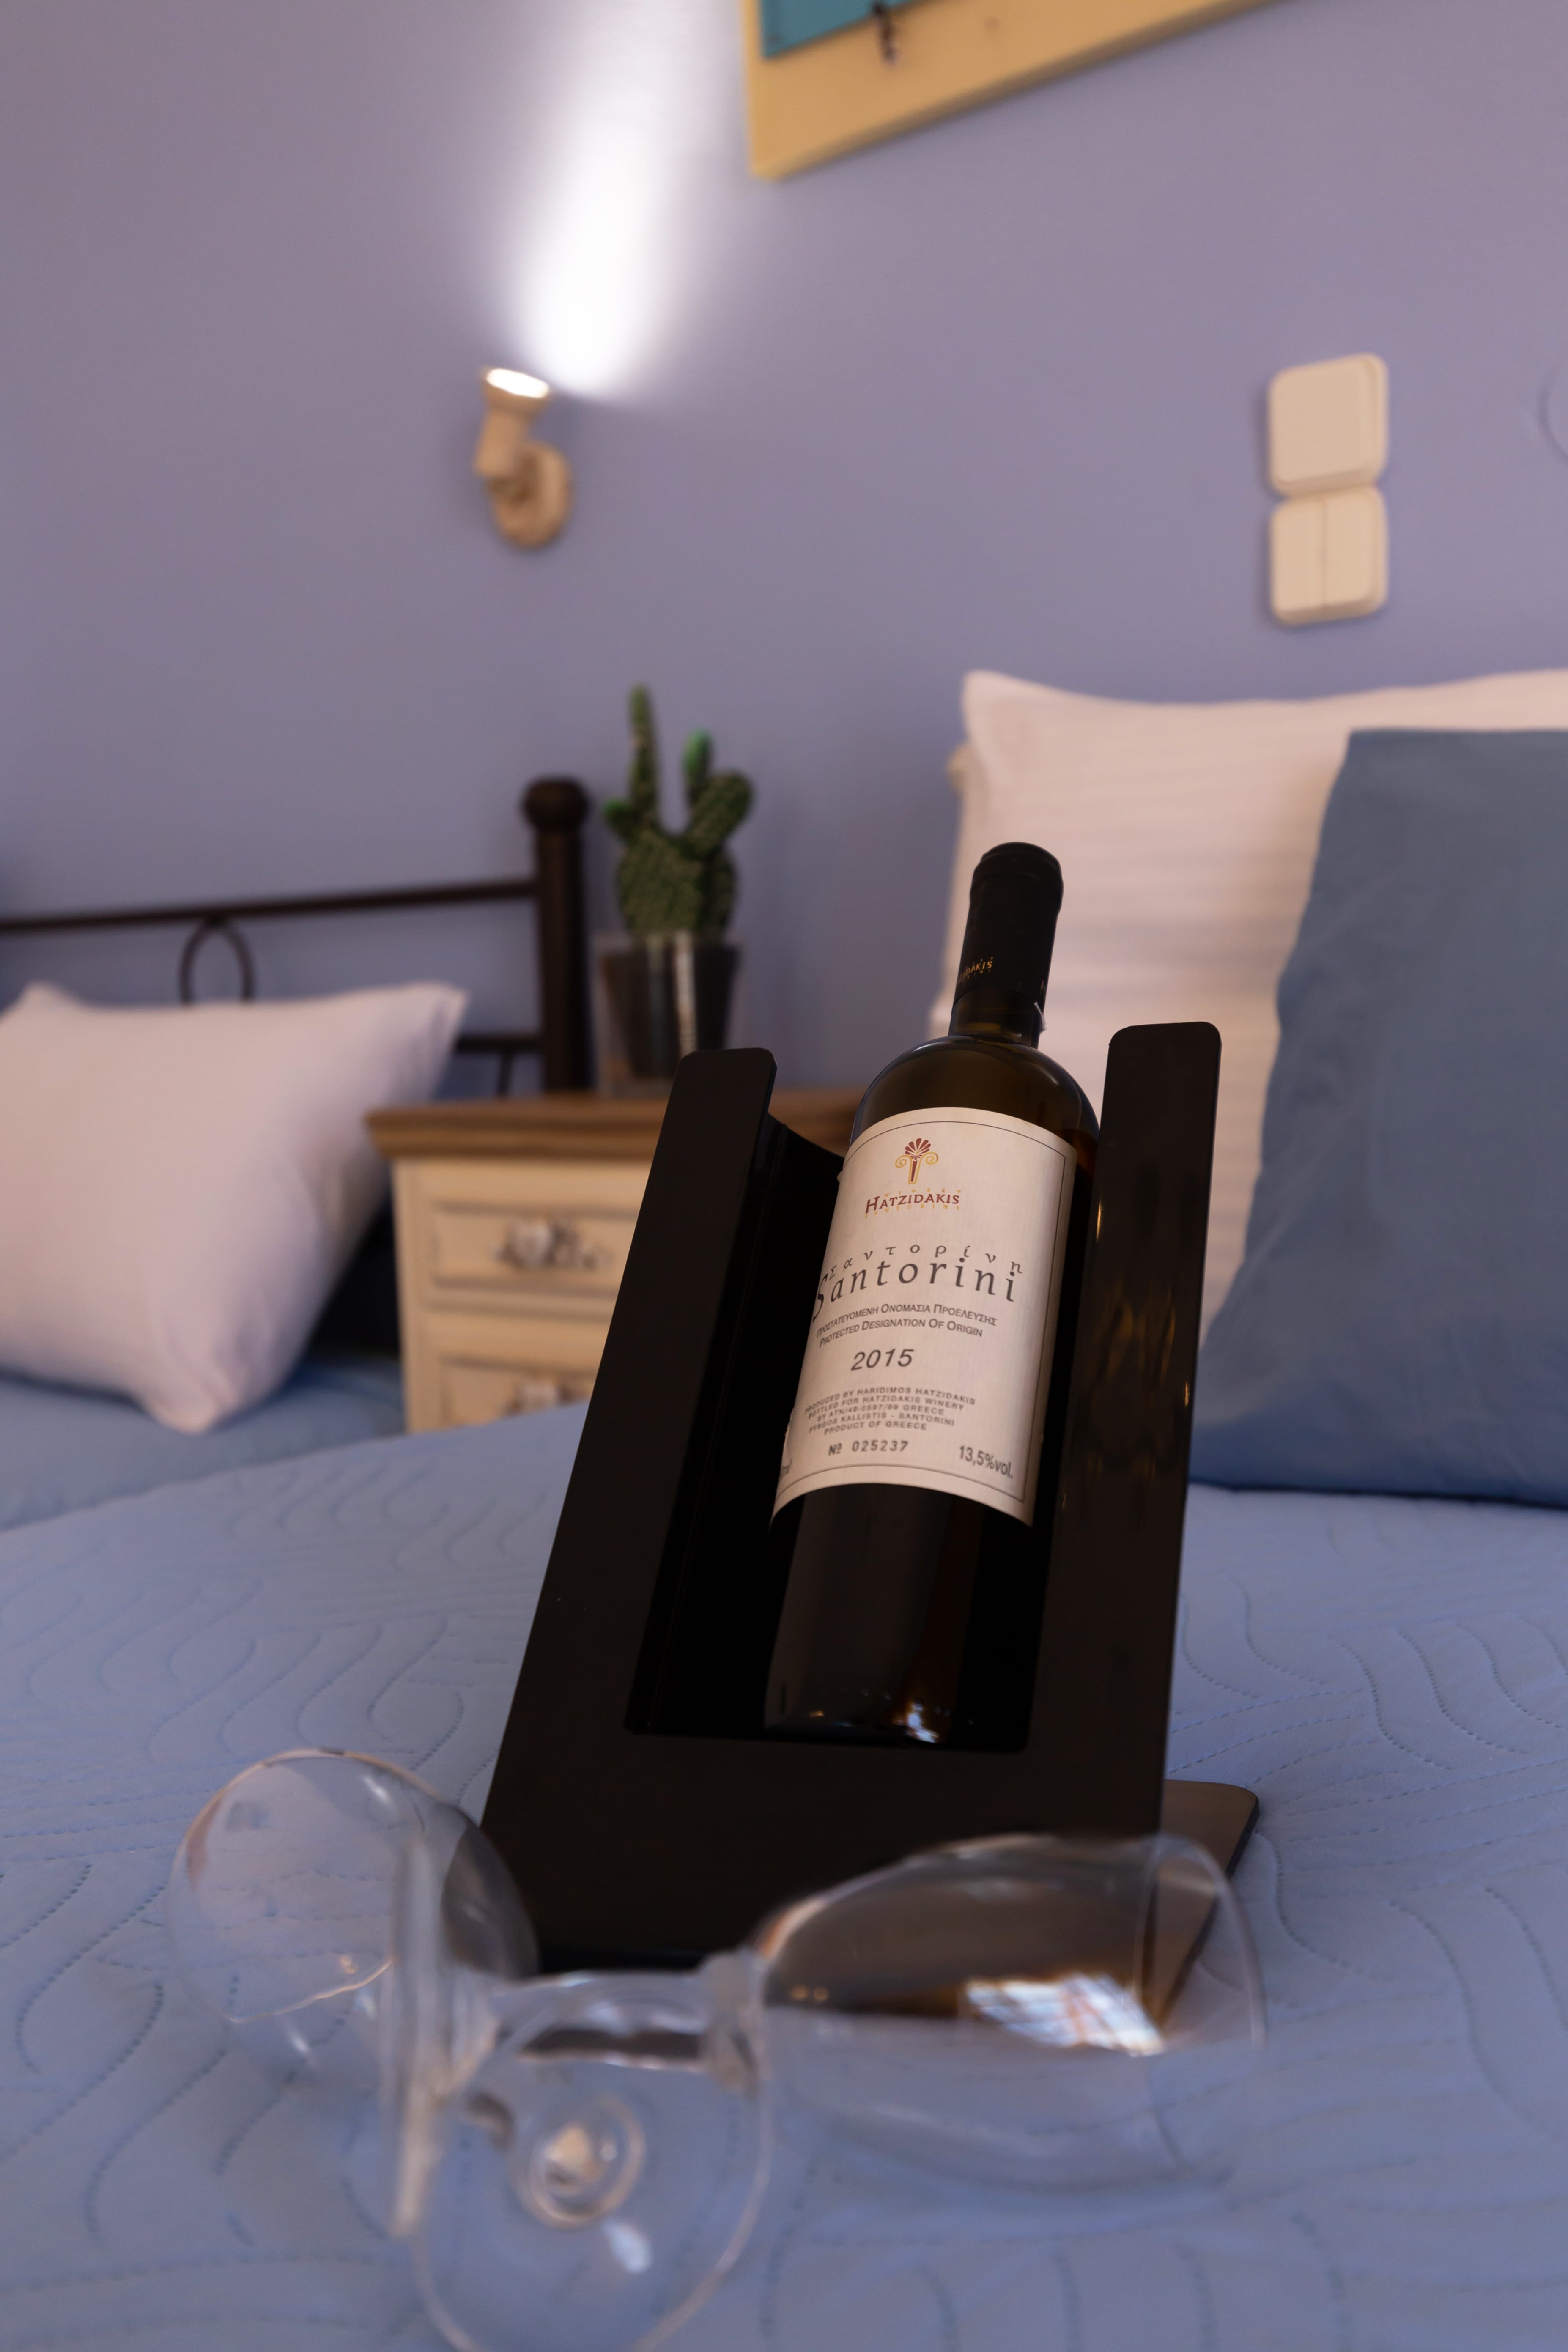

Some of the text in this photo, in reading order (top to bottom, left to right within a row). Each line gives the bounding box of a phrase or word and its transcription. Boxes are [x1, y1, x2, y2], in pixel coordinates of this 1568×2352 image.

[865, 1194, 960, 1214] HATZIDAKIS
[884, 1188, 961, 1198] WINERY
[865, 1204, 959, 1218] SANTORINI
[829, 1245, 1022, 1280] Σαντορίνη
[812, 1257, 1014, 1323] Santorini
[819, 1324, 860, 1348] PROTECTED
[861, 1319, 926, 1331] DESIGNATION
[947, 1321, 983, 1337] ORIGIN
[851, 1349, 914, 1371] 2015
[805, 1387, 976, 1415] PRODUCED BY HARIDIMOS HATZIDAKIS
[808, 1402, 839, 1420] BOTTLED
[842, 1398, 859, 1406] FOR
[925, 1398, 965, 1411] WINERY
[809, 1418, 838, 1434] PYRGOS
[841, 1412, 887, 1421] KALLISTIS
[899, 1413, 955, 1426] SANTORINI
[817, 1414, 827, 1422] BY
[902, 1405, 944, 1415] GREECE
[824, 1422, 865, 1435] PRODUCT
[885, 1421, 927, 1431] GREECE
[852, 1440, 908, 1452] 025237
